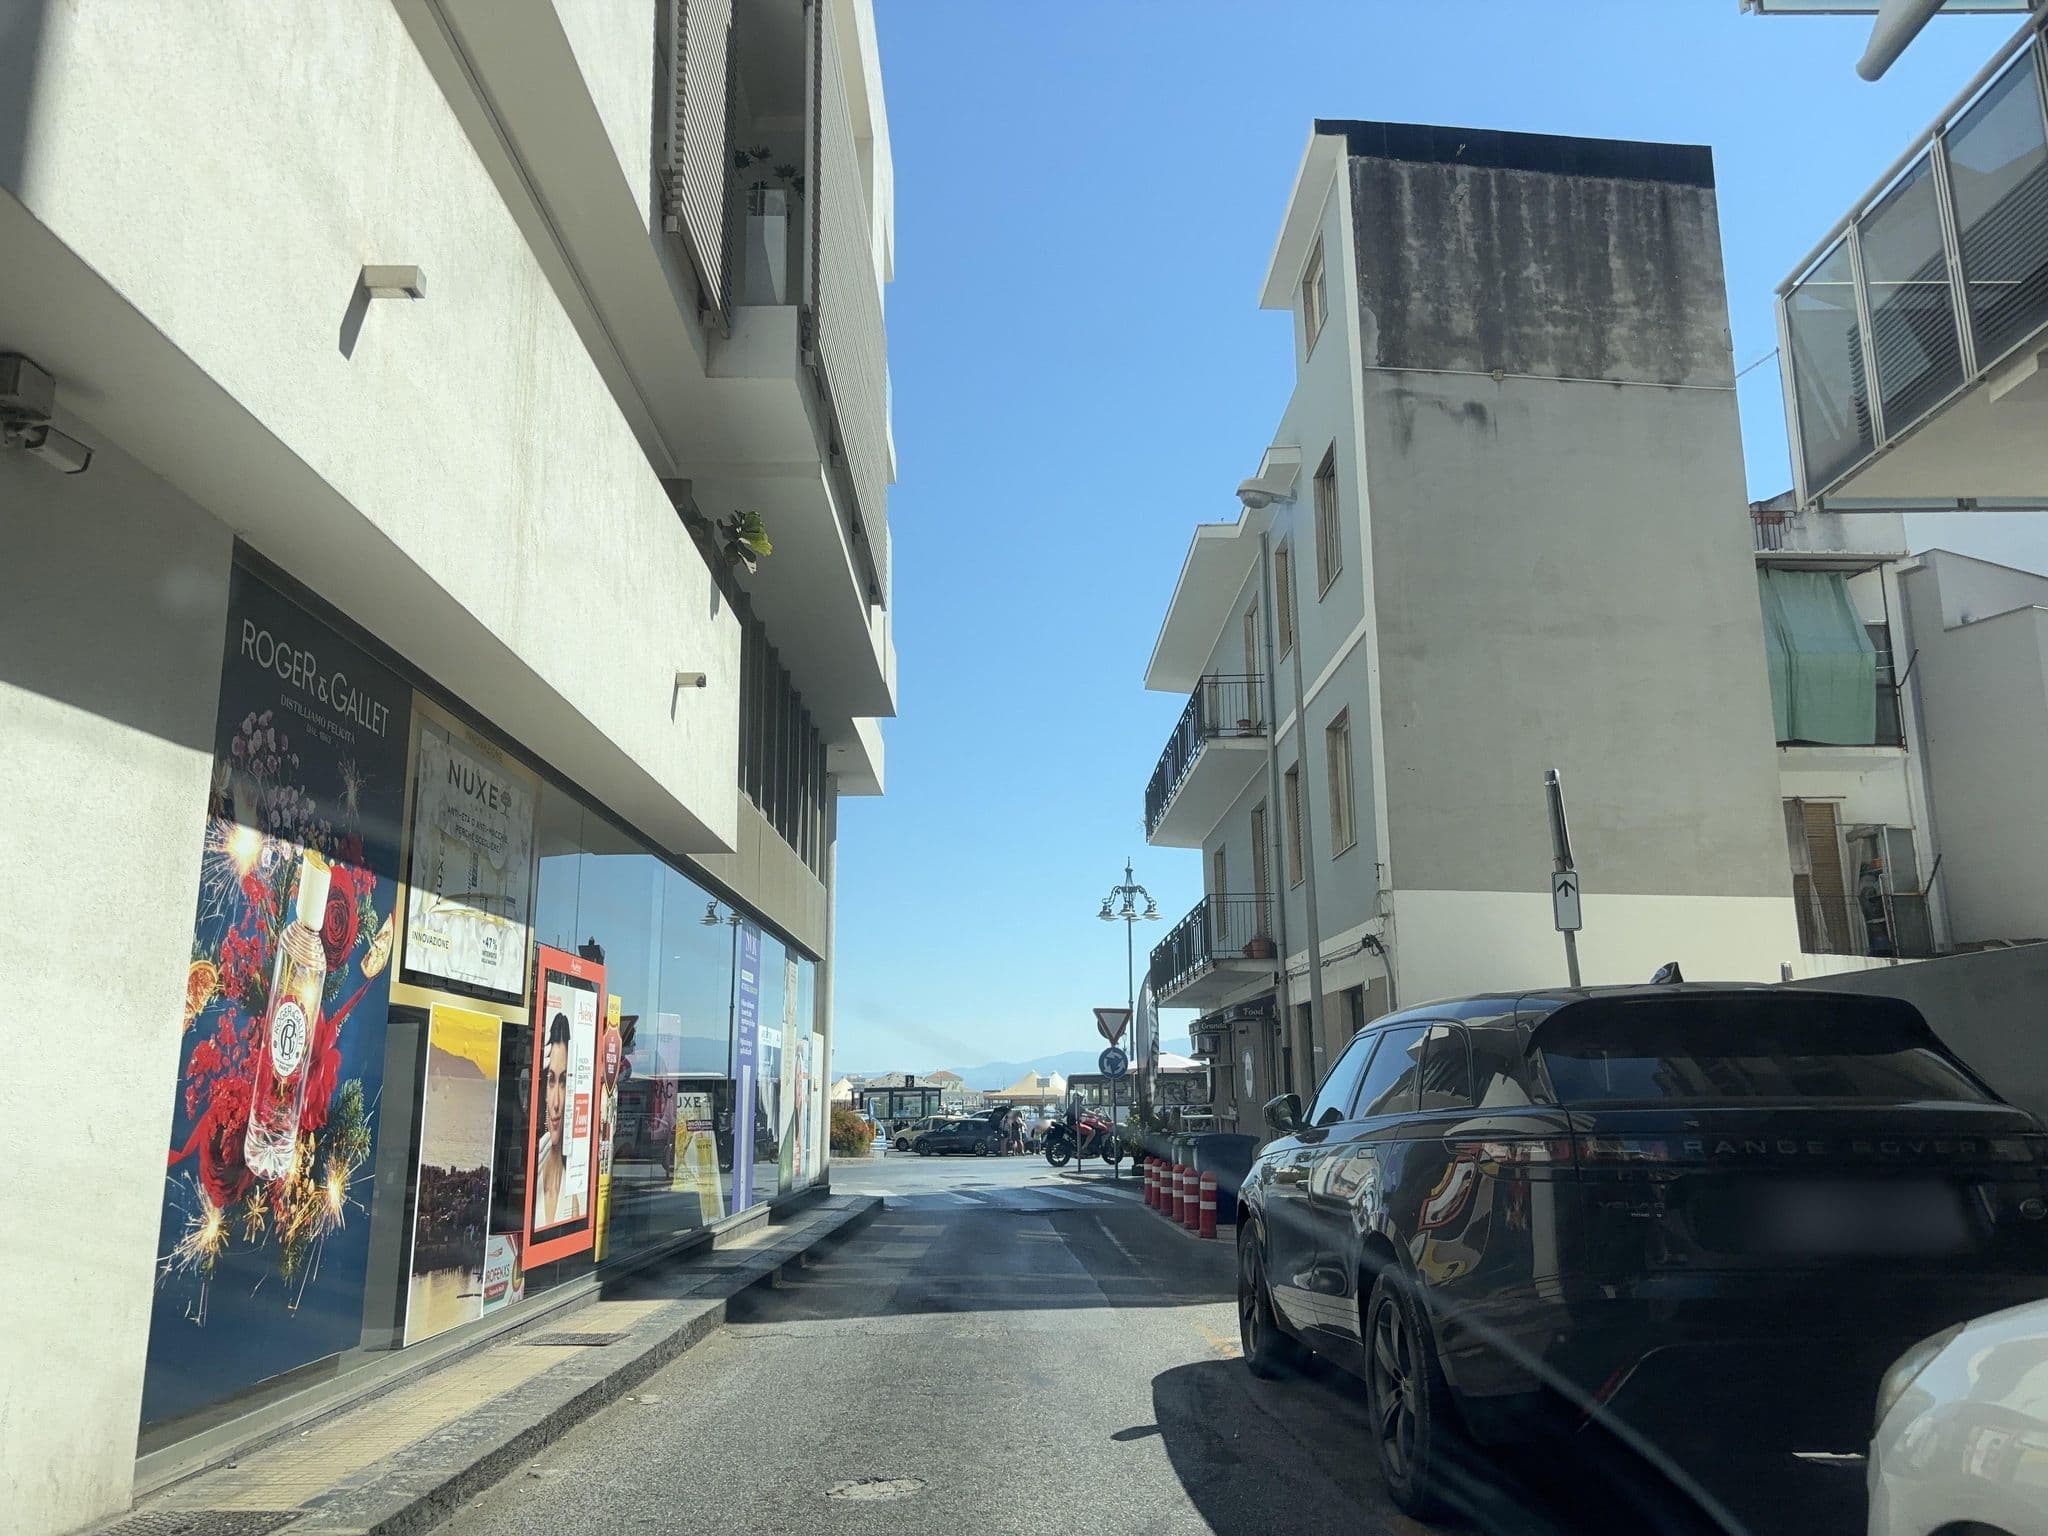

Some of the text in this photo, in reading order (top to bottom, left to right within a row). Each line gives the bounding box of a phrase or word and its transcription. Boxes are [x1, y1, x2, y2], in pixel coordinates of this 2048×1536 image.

[241, 618, 390, 738] ROGER & GALLET
[280, 694, 327, 728] DISTILLIAMO
[447, 759, 499, 811] NUXE
[411, 930, 451, 951] INNOVAZIONE
[1242, 1006, 1264, 1017] Food
[1683, 1140, 1977, 1154] RANGE ROVER
